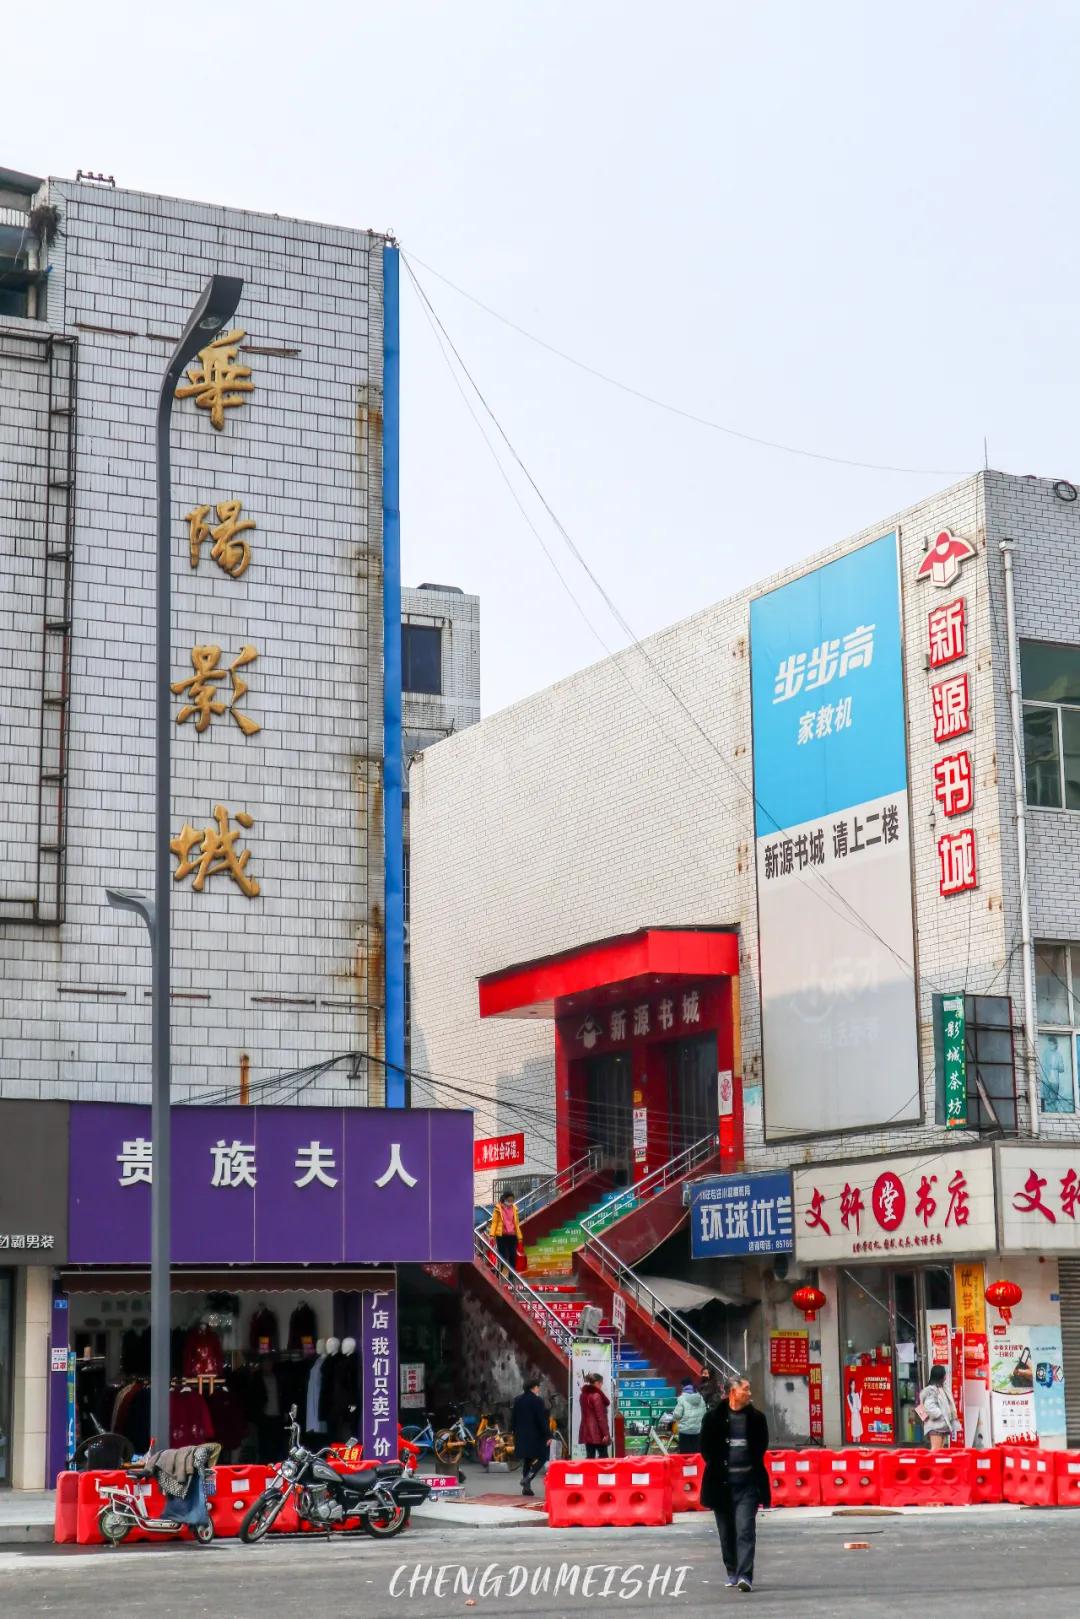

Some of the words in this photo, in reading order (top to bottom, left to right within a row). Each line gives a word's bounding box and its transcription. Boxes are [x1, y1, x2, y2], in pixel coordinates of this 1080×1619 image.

[773, 624, 876, 704] 步步高
[797, 697, 853, 745] 家教机
[928, 597, 979, 897] 新源书城
[764, 828, 826, 881] 新源书城
[832, 804, 900, 859] 请上二楼
[611, 991, 700, 1041] 新源书城
[945, 1020, 963, 1115] 影城茶坊
[117, 1138, 418, 1188] 贵族夫人
[371, 1337, 391, 1457] 我们只卖厂价
